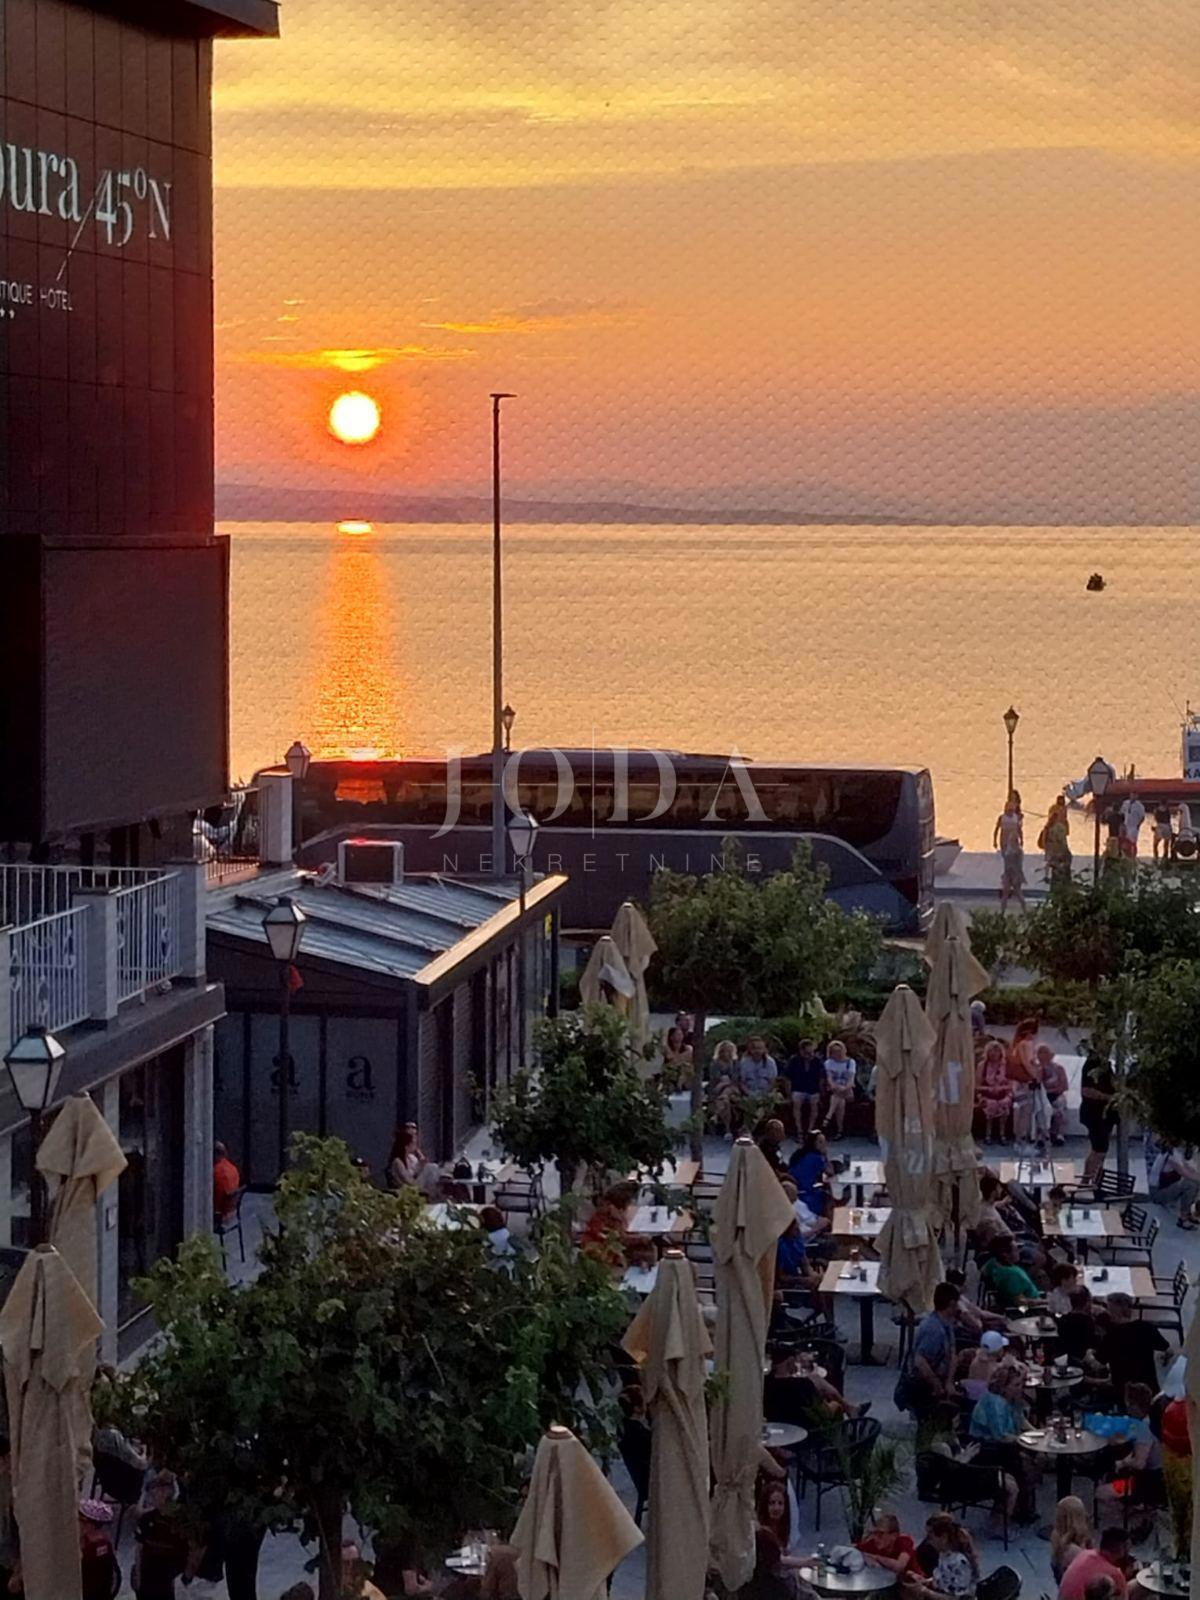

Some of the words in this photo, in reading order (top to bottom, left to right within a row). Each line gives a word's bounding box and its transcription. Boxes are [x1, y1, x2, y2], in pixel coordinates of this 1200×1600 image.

[0, 143, 82, 222] ura
[0, 280, 33, 305] TIQUE
[40, 288, 73, 311] HOTEL
[346, 1055, 376, 1090] a
